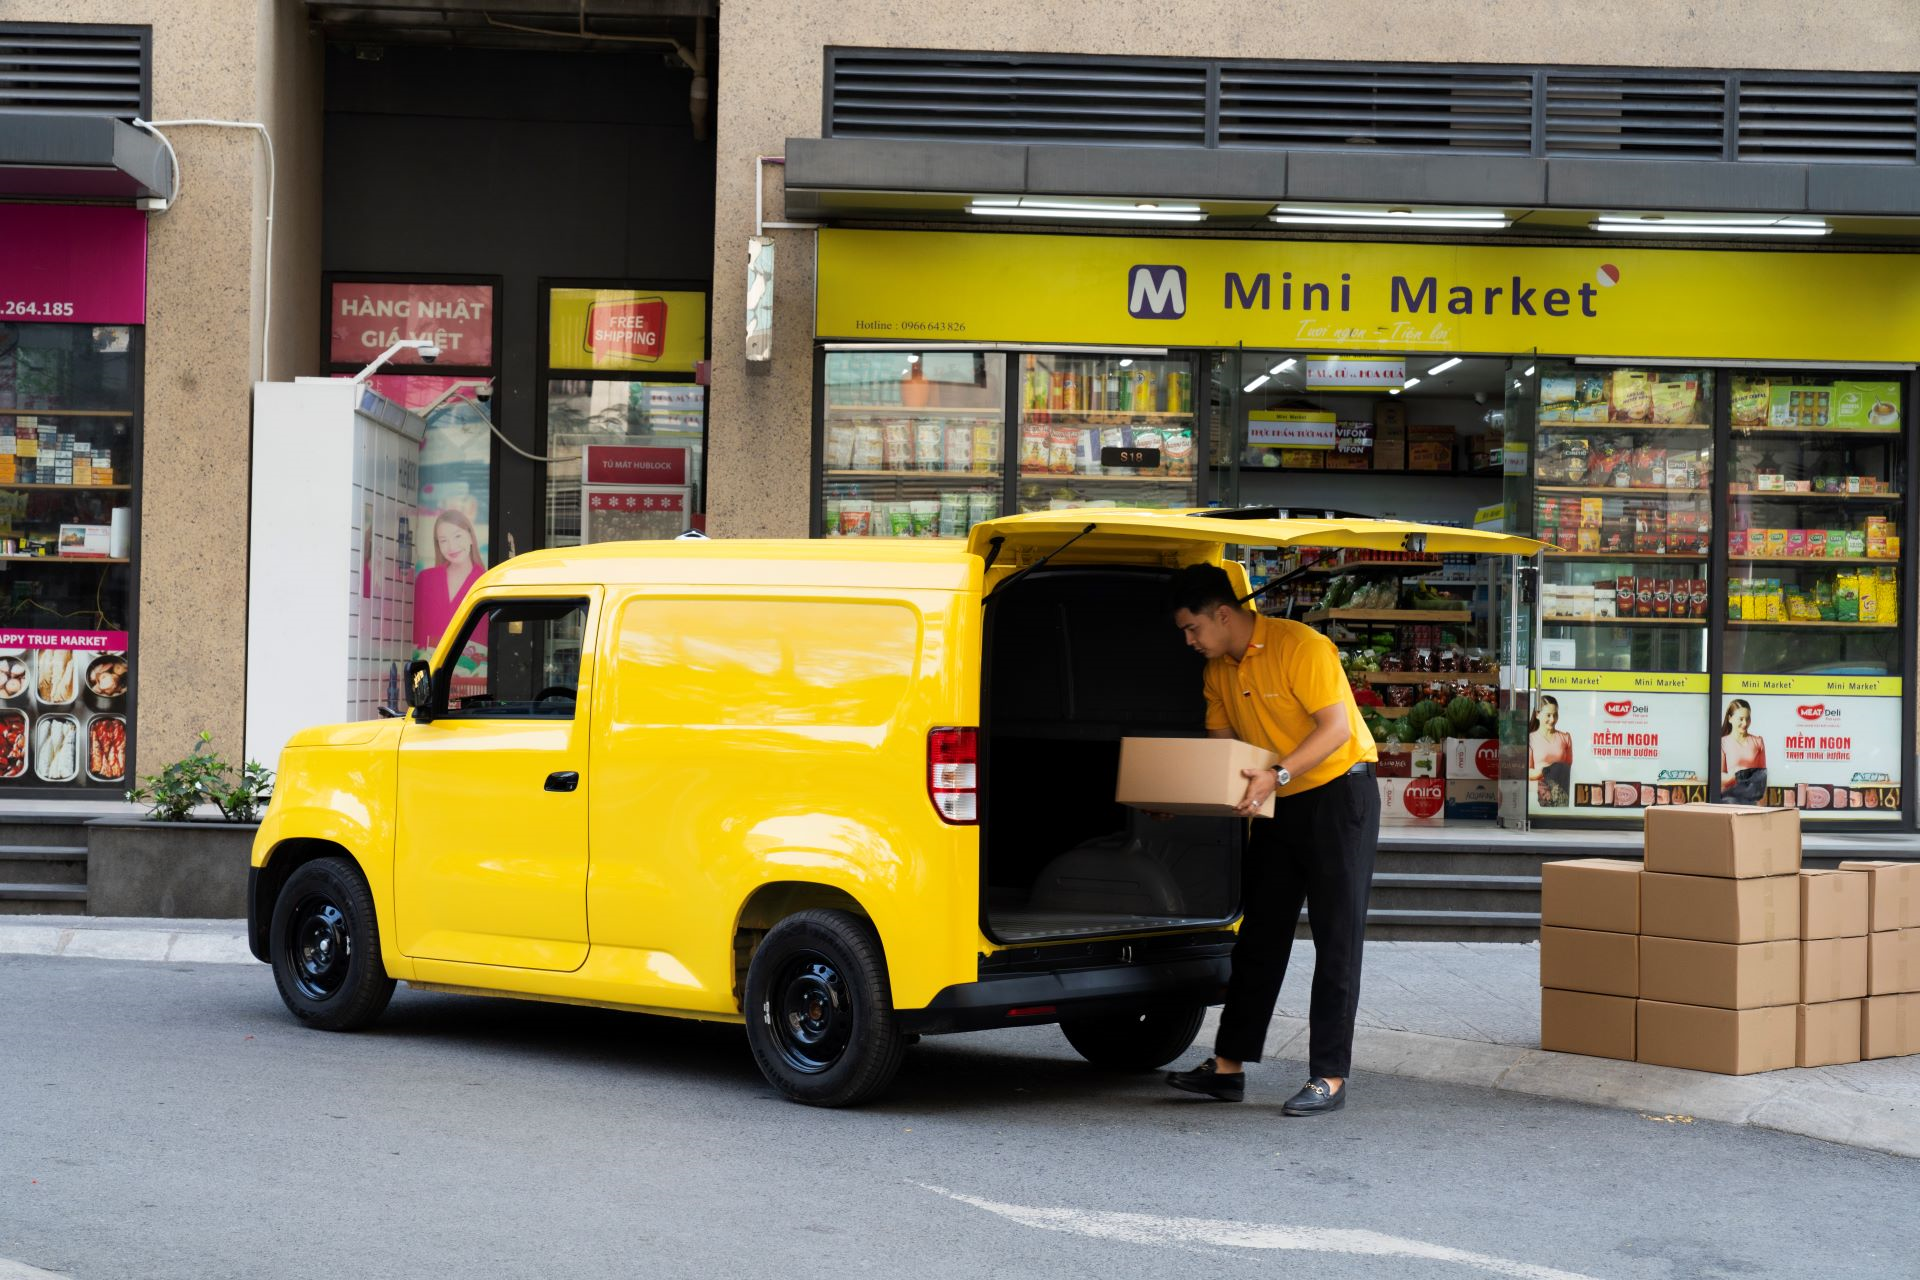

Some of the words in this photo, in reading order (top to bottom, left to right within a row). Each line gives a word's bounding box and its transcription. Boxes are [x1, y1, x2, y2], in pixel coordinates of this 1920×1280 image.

[1223, 271, 1351, 311] Mini
[1390, 275, 1598, 317] Market
[341, 295, 411, 318] HÀNG
[418, 298, 485, 324] NHẬT
[609, 315, 645, 329] FREE
[855, 320, 892, 330] Hotline
[361, 327, 401, 348] GIÁ
[595, 329, 656, 346] SHIPPING
[1336, 428, 1367, 438] VIFON
[1120, 452, 1143, 462] S18
[633, 461, 672, 470] HUBLOCK
[27, 635, 57, 645] TRUE
[60, 636, 107, 646] MARKET
[1549, 676, 1567, 684] Mini
[1571, 676, 1600, 685] Market
[1634, 678, 1653, 686] Mini
[1656, 679, 1685, 687] Market
[1741, 680, 1760, 688] Mini
[1763, 681, 1792, 689] Market
[1827, 682, 1845, 690] Mini
[1848, 682, 1877, 690] Market
[1608, 704, 1630, 713] MEAT
[1632, 705, 1649, 713] Deli
[1800, 708, 1823, 716] MEAT
[1825, 709, 1841, 717] Deli
[1627, 733, 1659, 747] NGON
[1819, 737, 1851, 750] NGON
